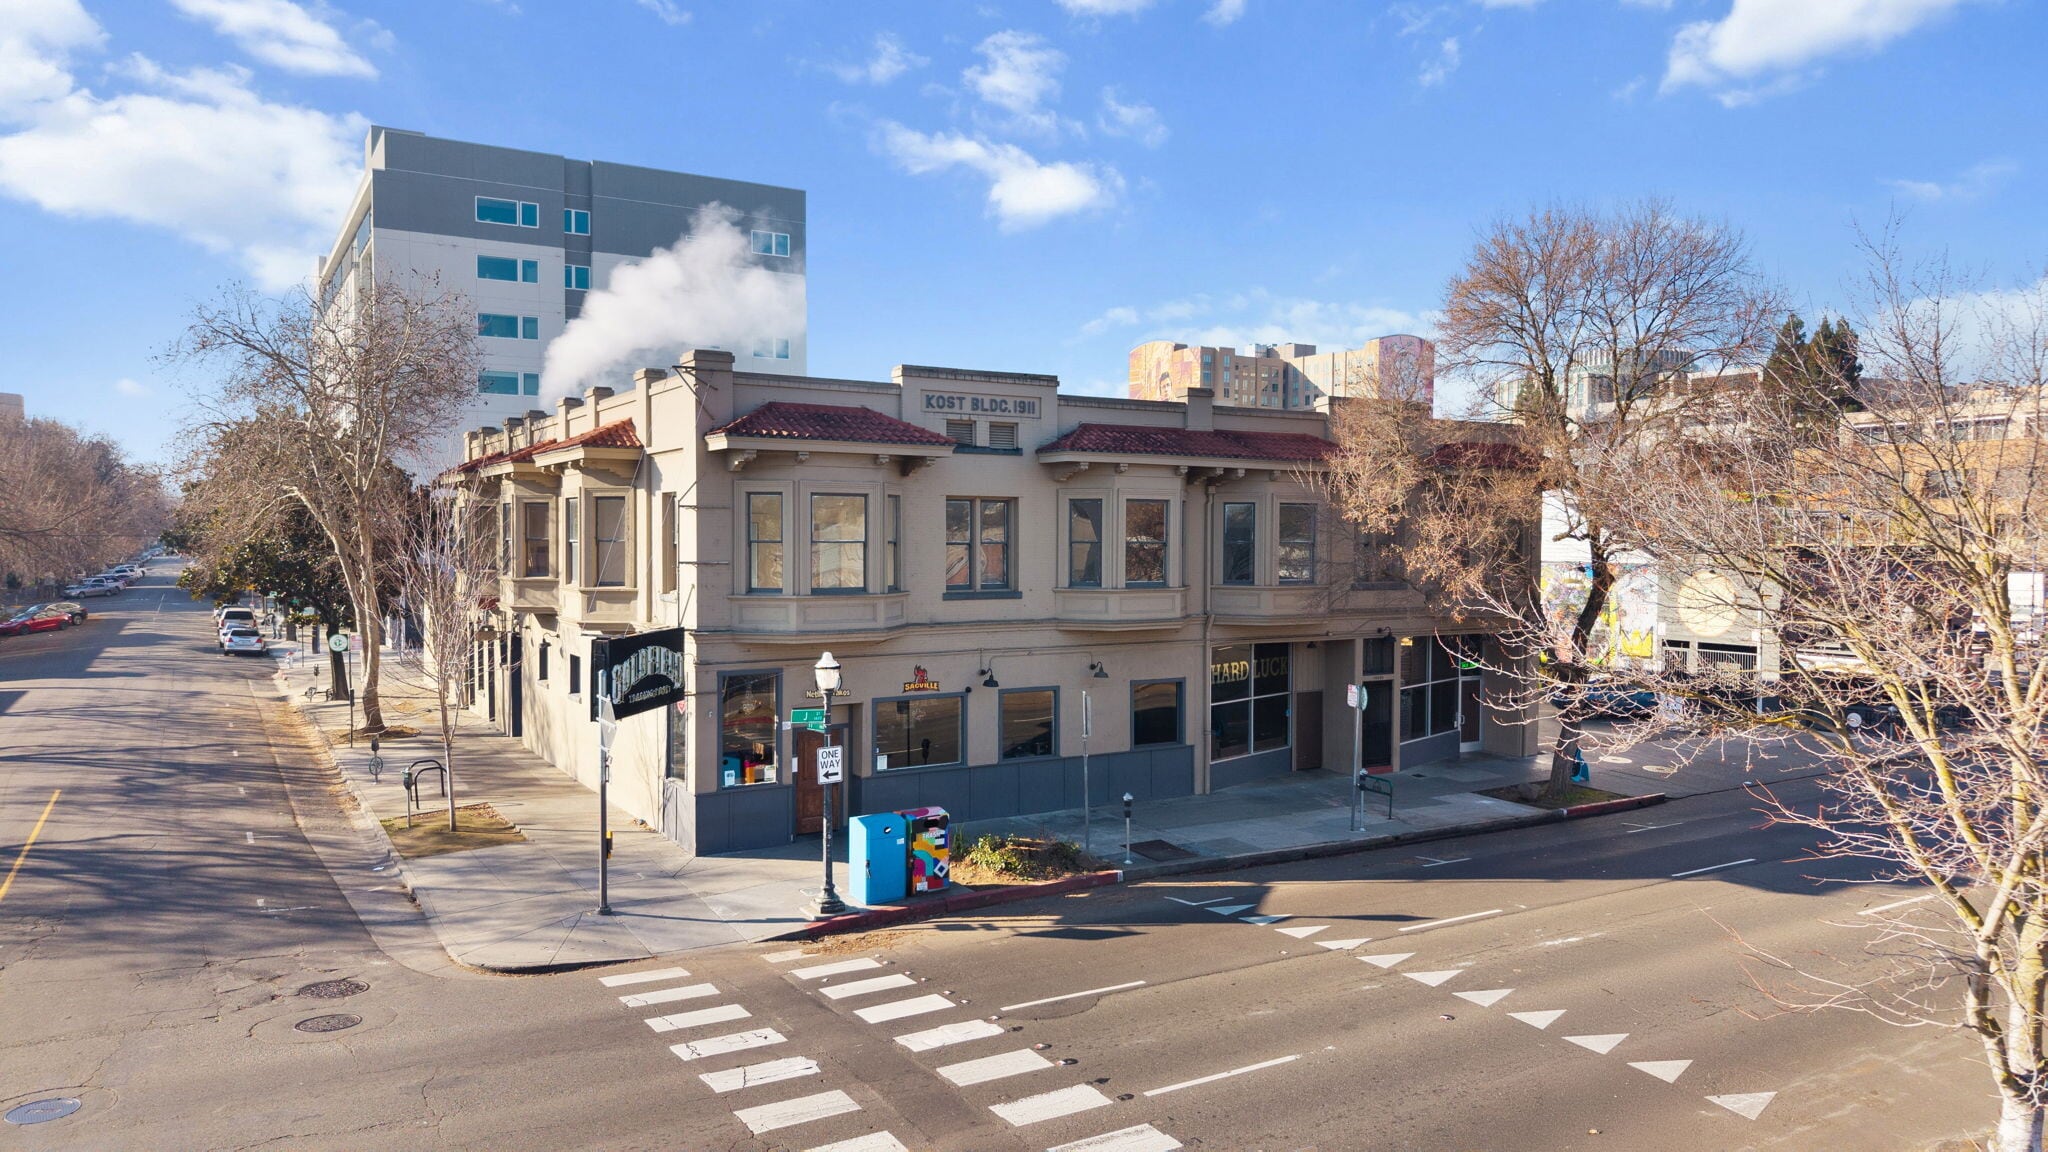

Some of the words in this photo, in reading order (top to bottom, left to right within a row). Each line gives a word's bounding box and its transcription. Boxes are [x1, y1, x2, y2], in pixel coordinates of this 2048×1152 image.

[925, 394, 966, 410] KOST
[1013, 400, 1036, 414] 1911
[611, 645, 684, 705] GOLDFIELD
[1211, 660, 1250, 684] HARD
[1253, 656, 1288, 679] LUCK
[803, 712, 808, 721] J
[821, 750, 839, 760] ONE
[820, 759, 840, 770] WAY
